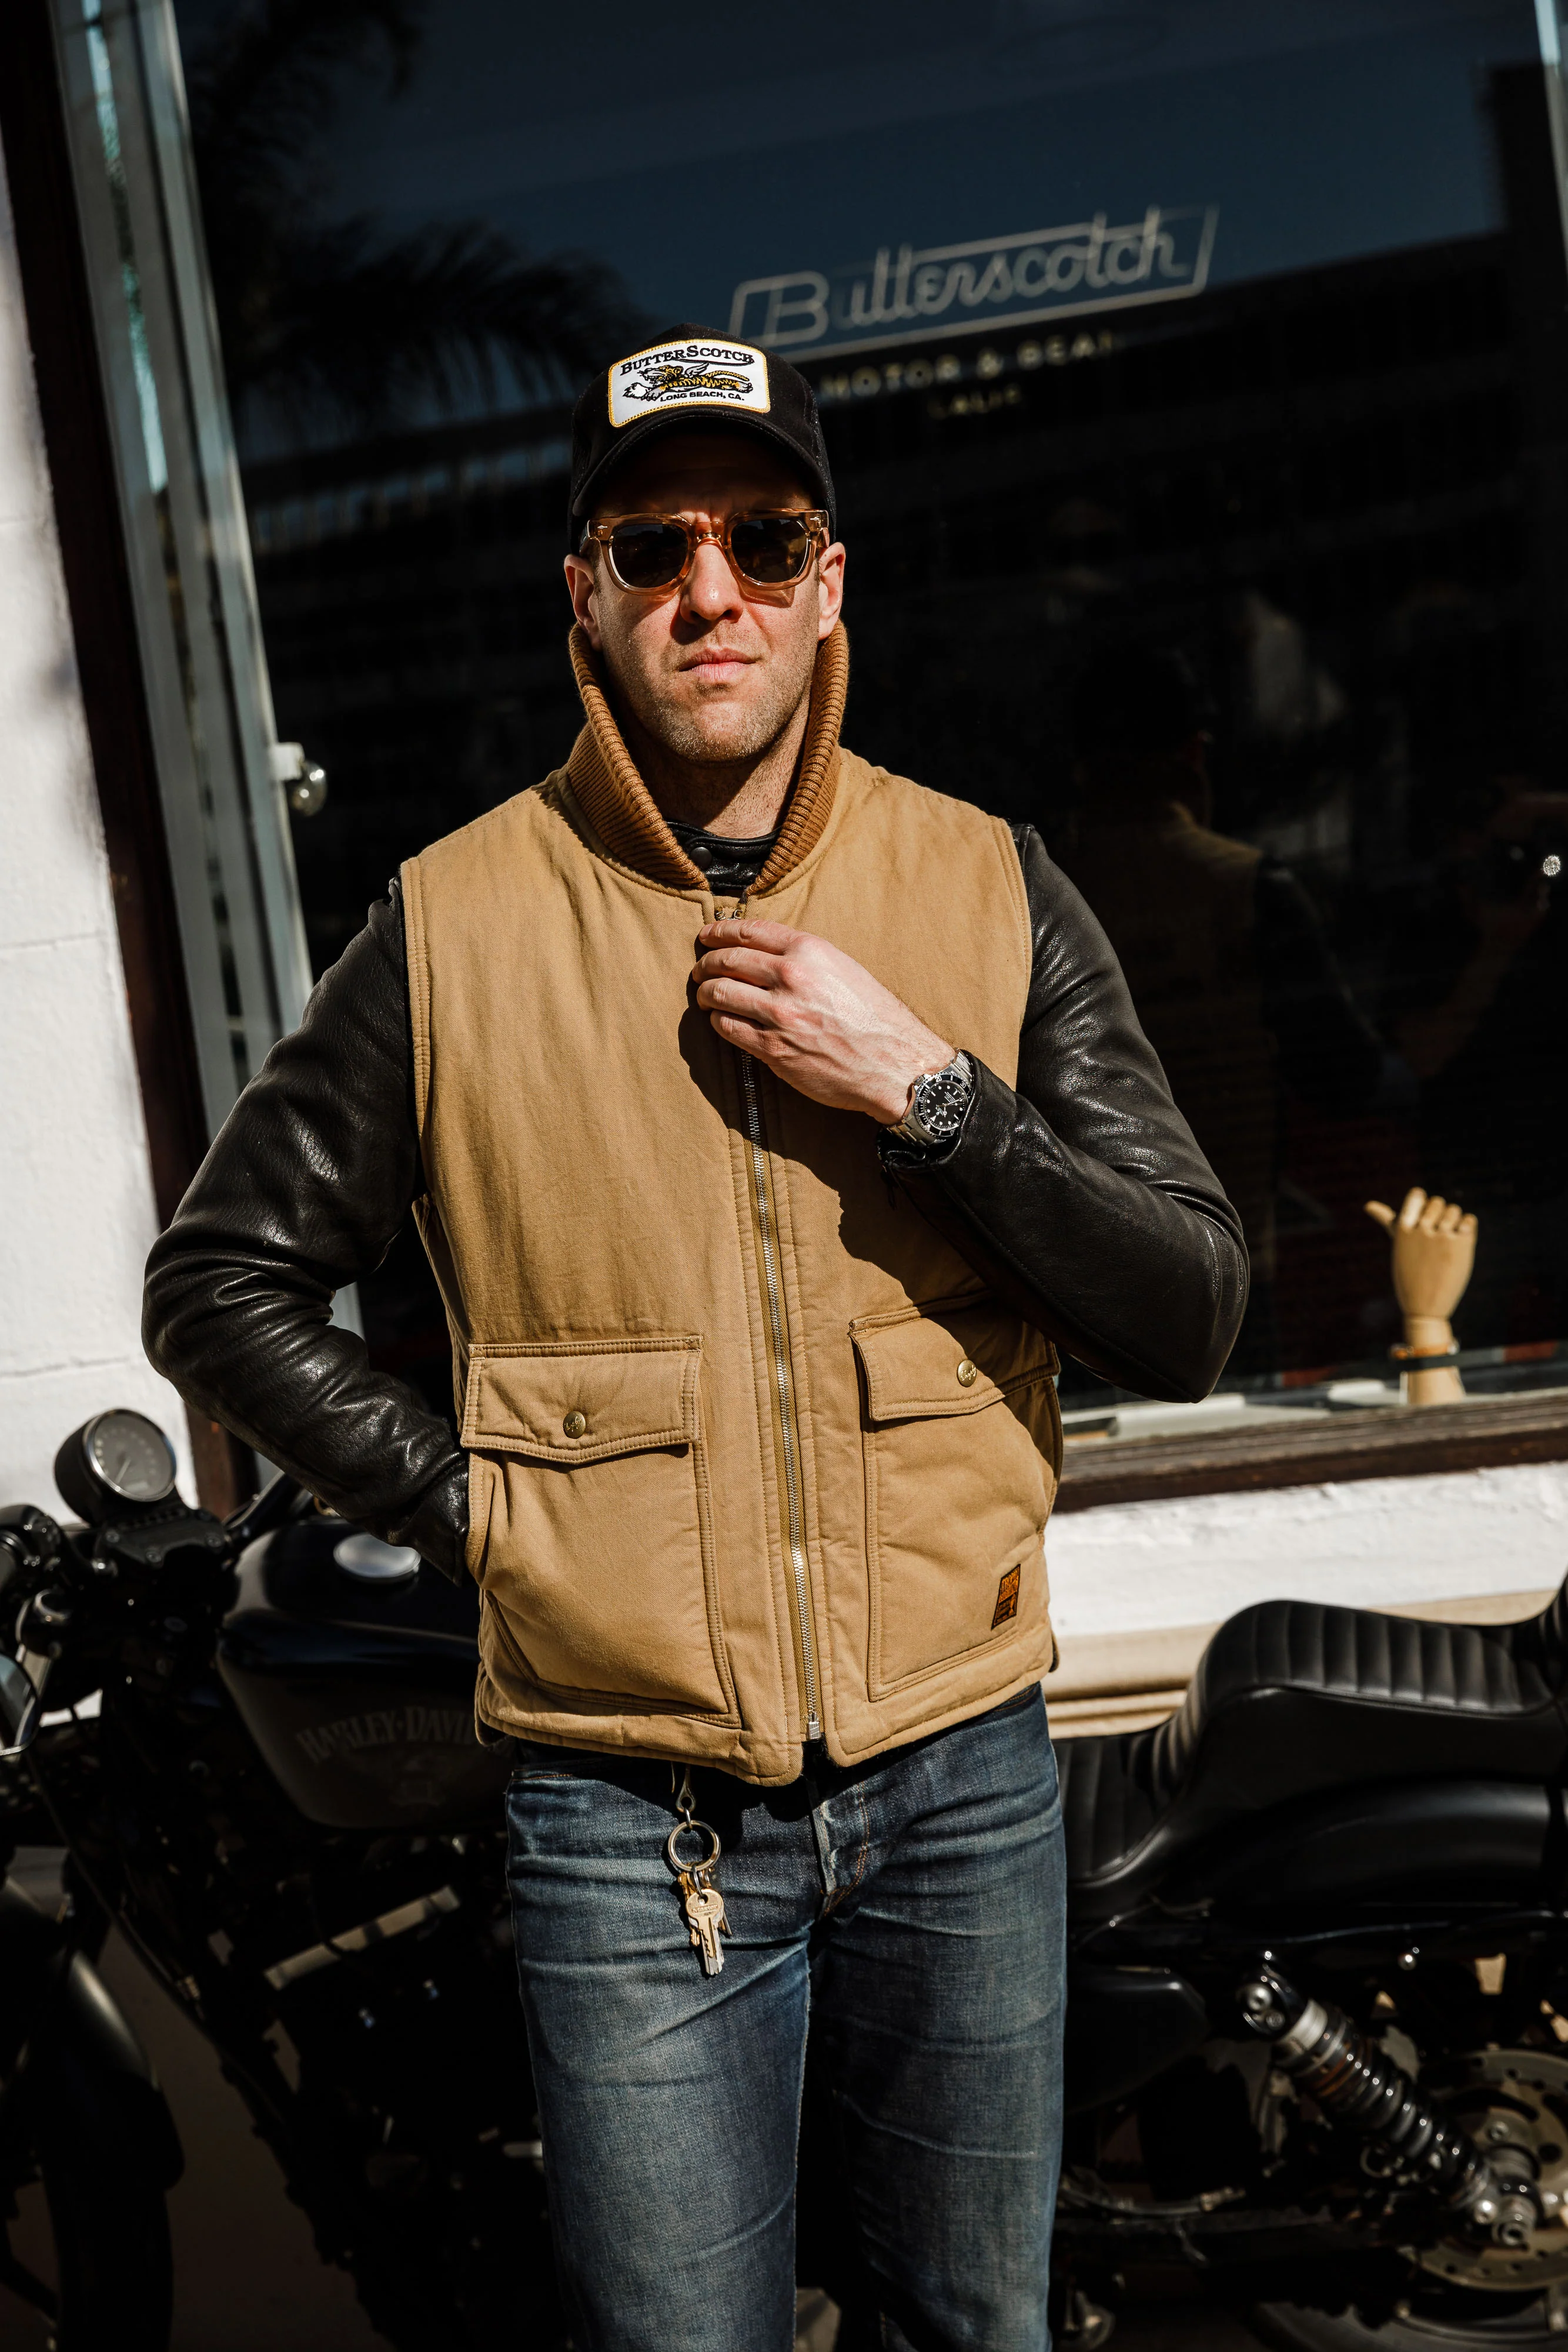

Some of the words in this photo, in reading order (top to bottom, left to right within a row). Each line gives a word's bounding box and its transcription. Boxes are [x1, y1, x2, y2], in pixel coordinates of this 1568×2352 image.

[763, 205, 1192, 348] Butterscotch
[660, 392, 687, 402] LONG
[690, 390, 726, 400] BEACH,
[820, 353, 961, 400] MOTOR
